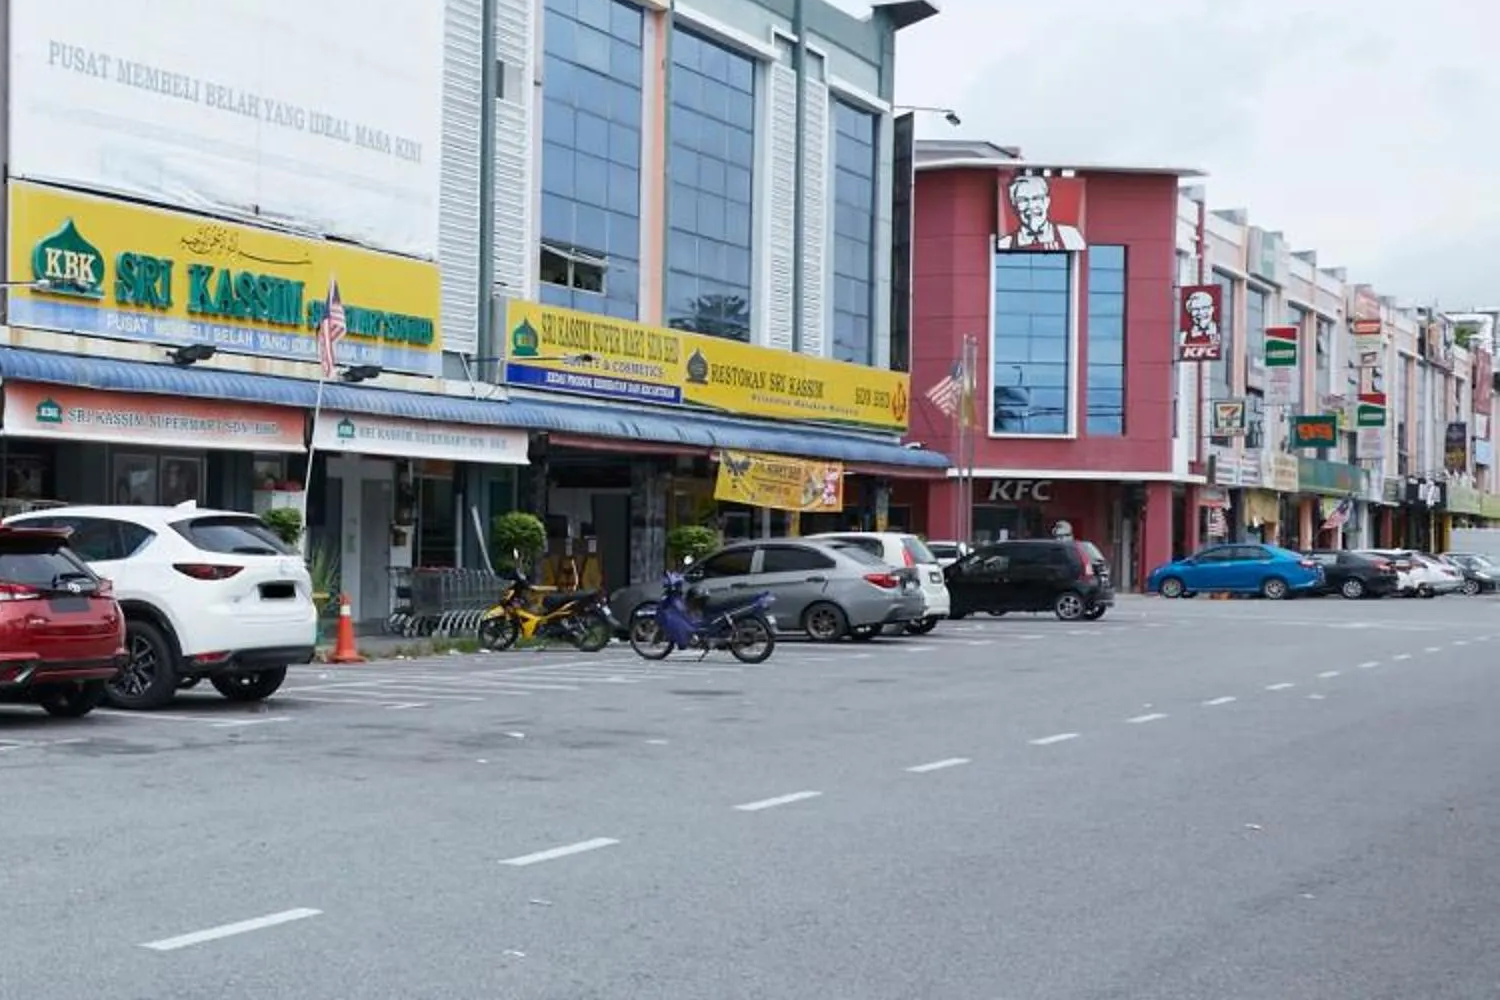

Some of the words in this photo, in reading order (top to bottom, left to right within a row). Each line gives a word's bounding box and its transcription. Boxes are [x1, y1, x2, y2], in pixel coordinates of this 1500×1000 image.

[48, 39, 111, 80] PUSAT
[205, 81, 260, 119] BELAH
[264, 98, 305, 131] YANG
[45, 247, 98, 284] KBK
[114, 251, 174, 309] SRI
[187, 263, 306, 328] KASSIM
[106, 313, 149, 335] PUSAT
[1183, 347, 1218, 358] KFC
[711, 363, 767, 390] RESTORAN
[769, 371, 786, 393] SRI
[789, 374, 825, 399] KASSIM
[989, 480, 1053, 501] KFC
